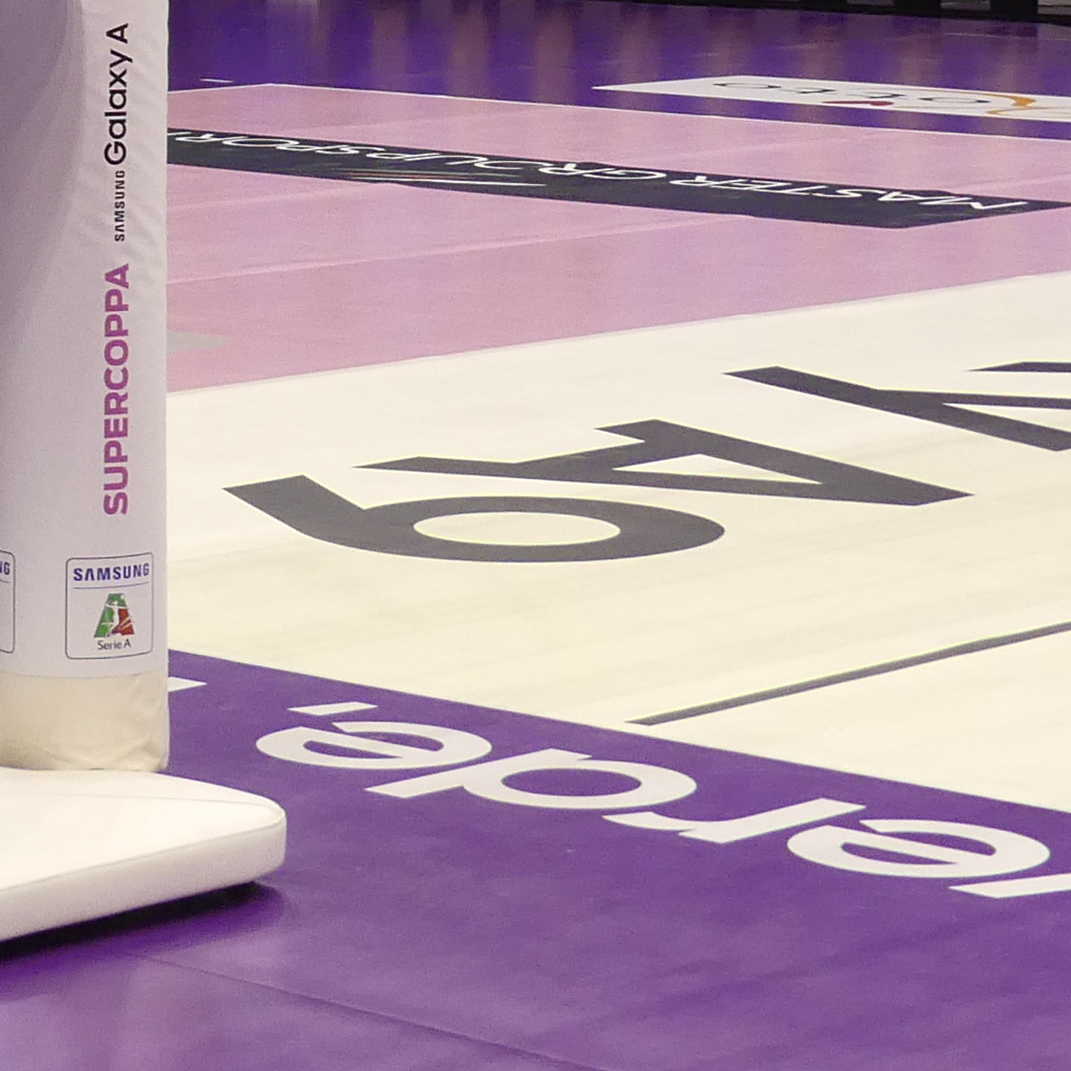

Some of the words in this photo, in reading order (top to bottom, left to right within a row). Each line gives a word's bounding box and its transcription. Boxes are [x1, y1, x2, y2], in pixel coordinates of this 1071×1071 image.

[106, 23, 129, 44] A
[104, 49, 133, 165] Galaxy
[366, 152, 666, 180] GROUP
[114, 170, 126, 242] SAMSUNG
[670, 175, 1028, 210] MASTER
[103, 263, 129, 515] SUPERCOPPA
[73, 563, 149, 581] SAMSUNG
[97, 640, 122, 650] Serie
[123, 638, 131, 648] A
